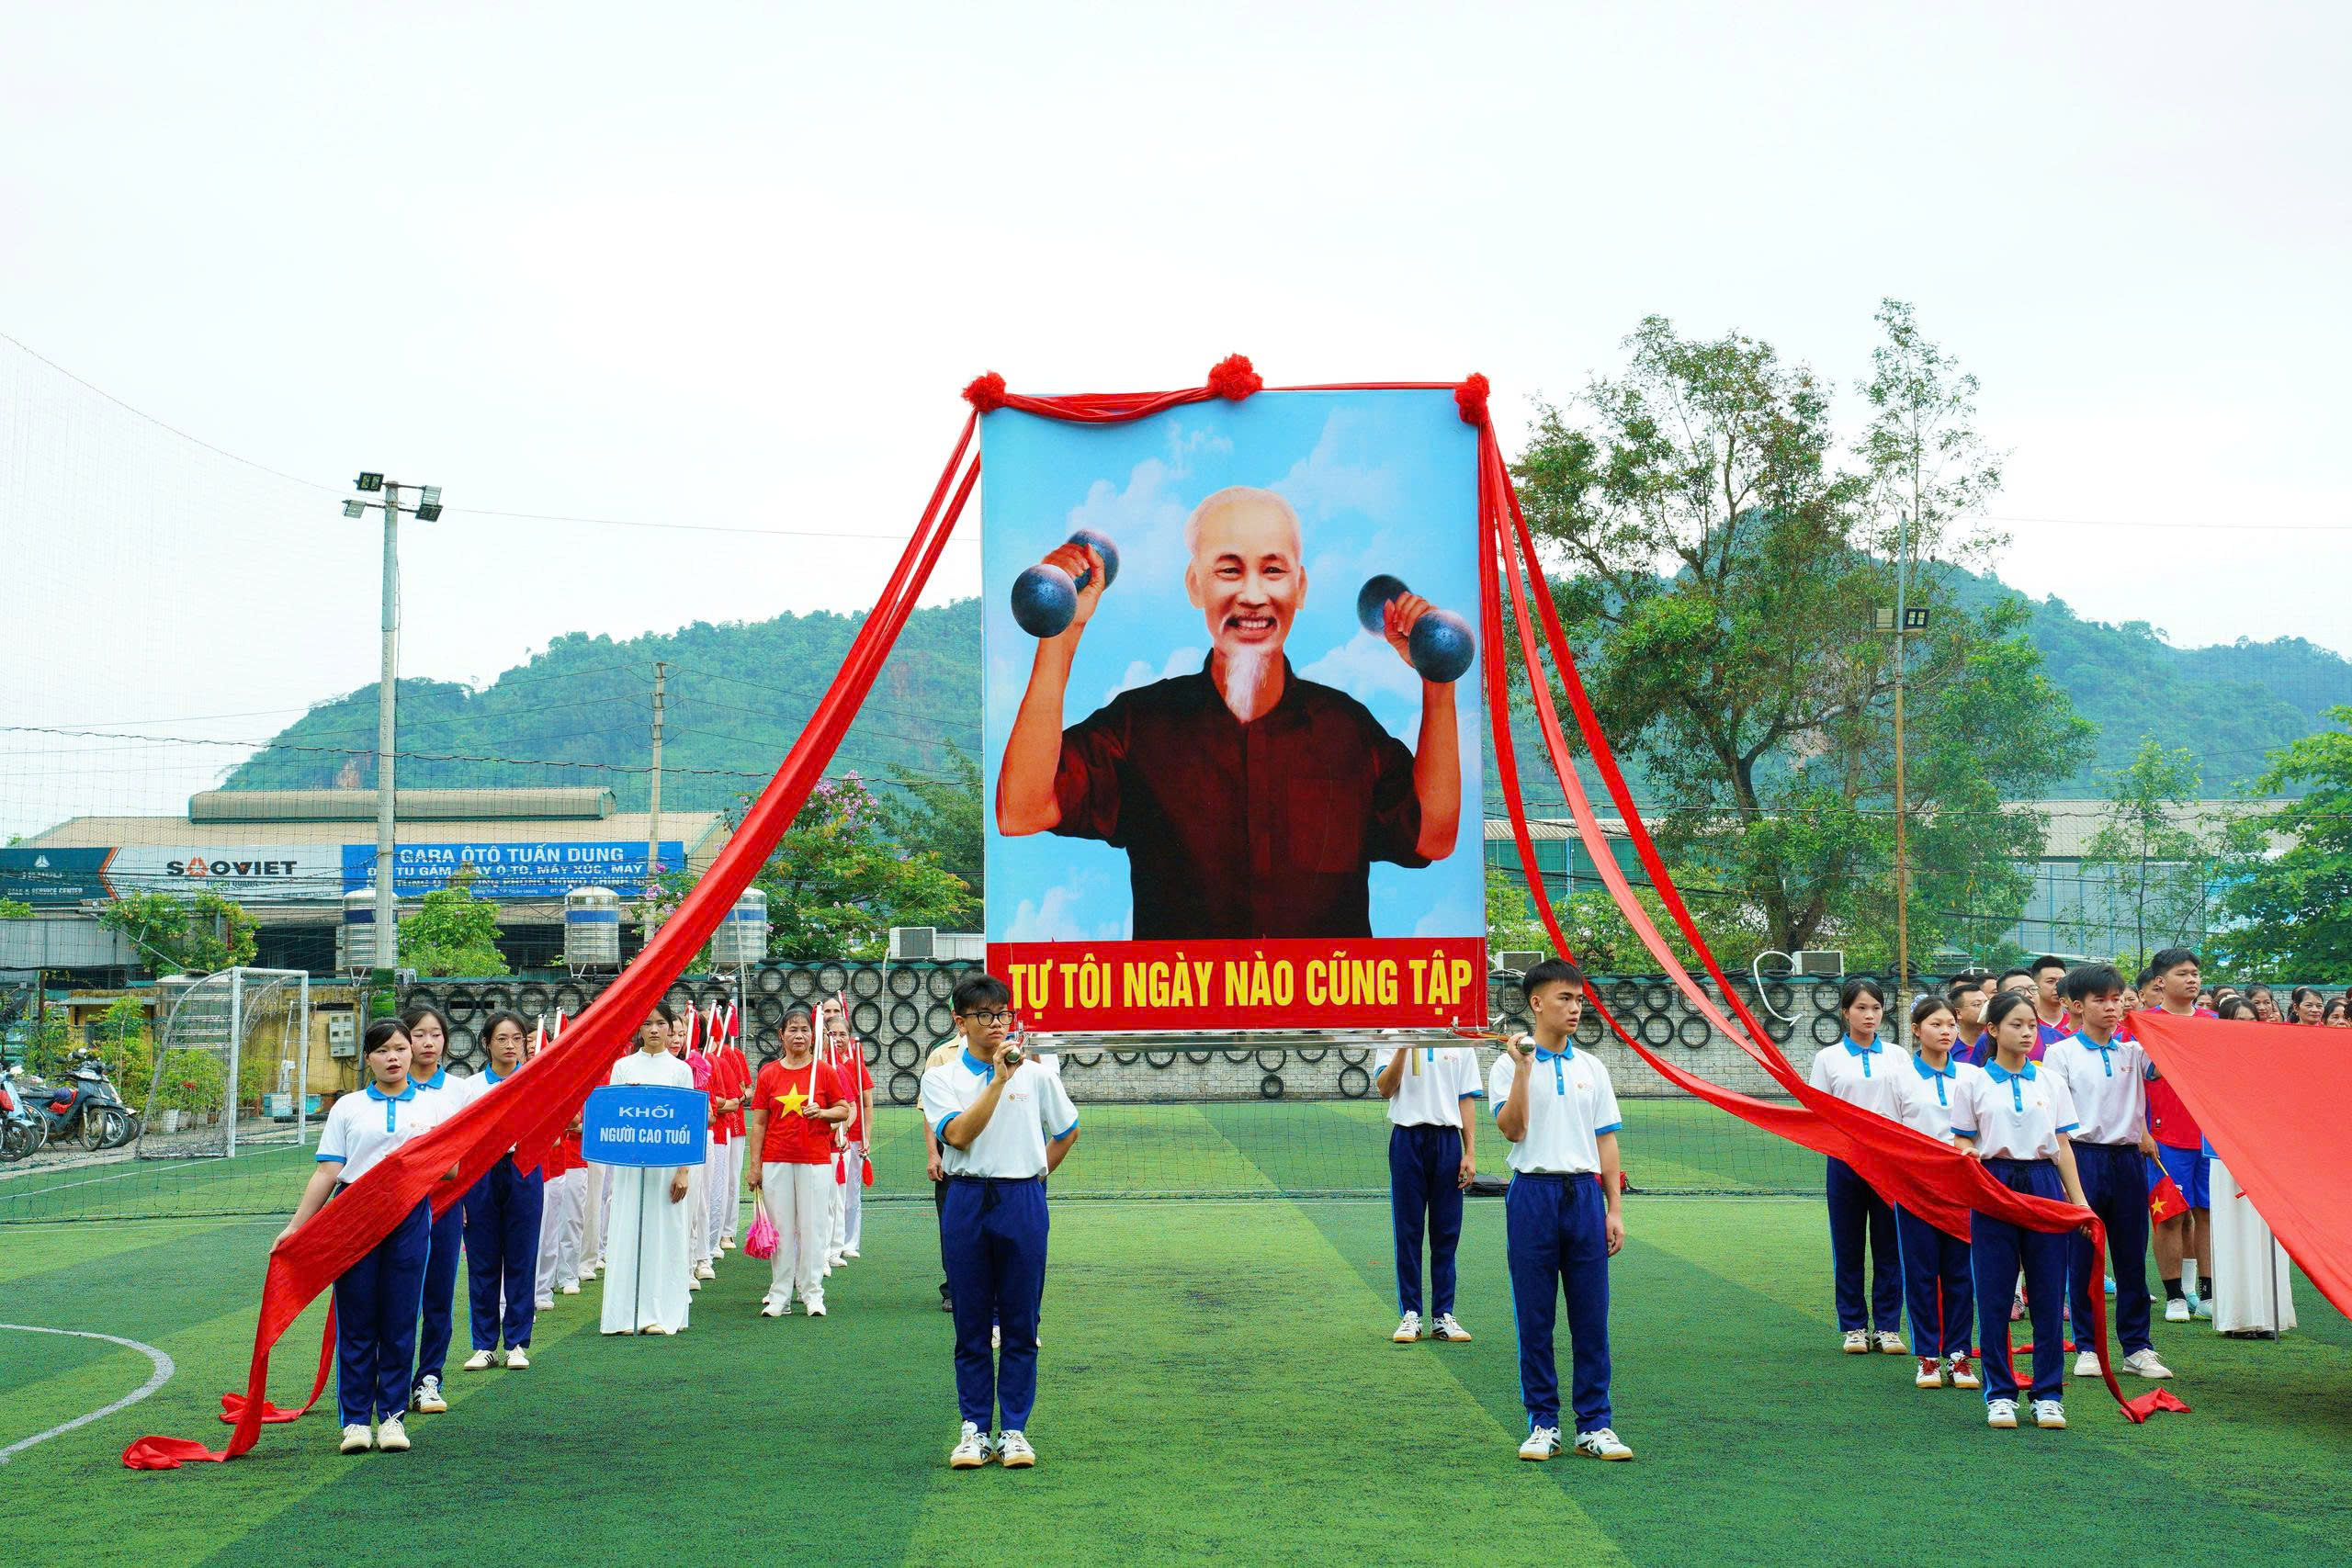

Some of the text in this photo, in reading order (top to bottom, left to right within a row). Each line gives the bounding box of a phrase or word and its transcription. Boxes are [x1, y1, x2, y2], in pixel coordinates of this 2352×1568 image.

[401, 849, 455, 863] GARA
[507, 843, 560, 863] TUẤN
[568, 847, 624, 863] DUNG
[1008, 950, 1472, 1020] TỰ TÔI NGÀY NÀO CŨNG TẬP
[618, 1104, 674, 1118] KHỐI
[599, 1123, 690, 1145] NGƯỜI CAO TUỔI
